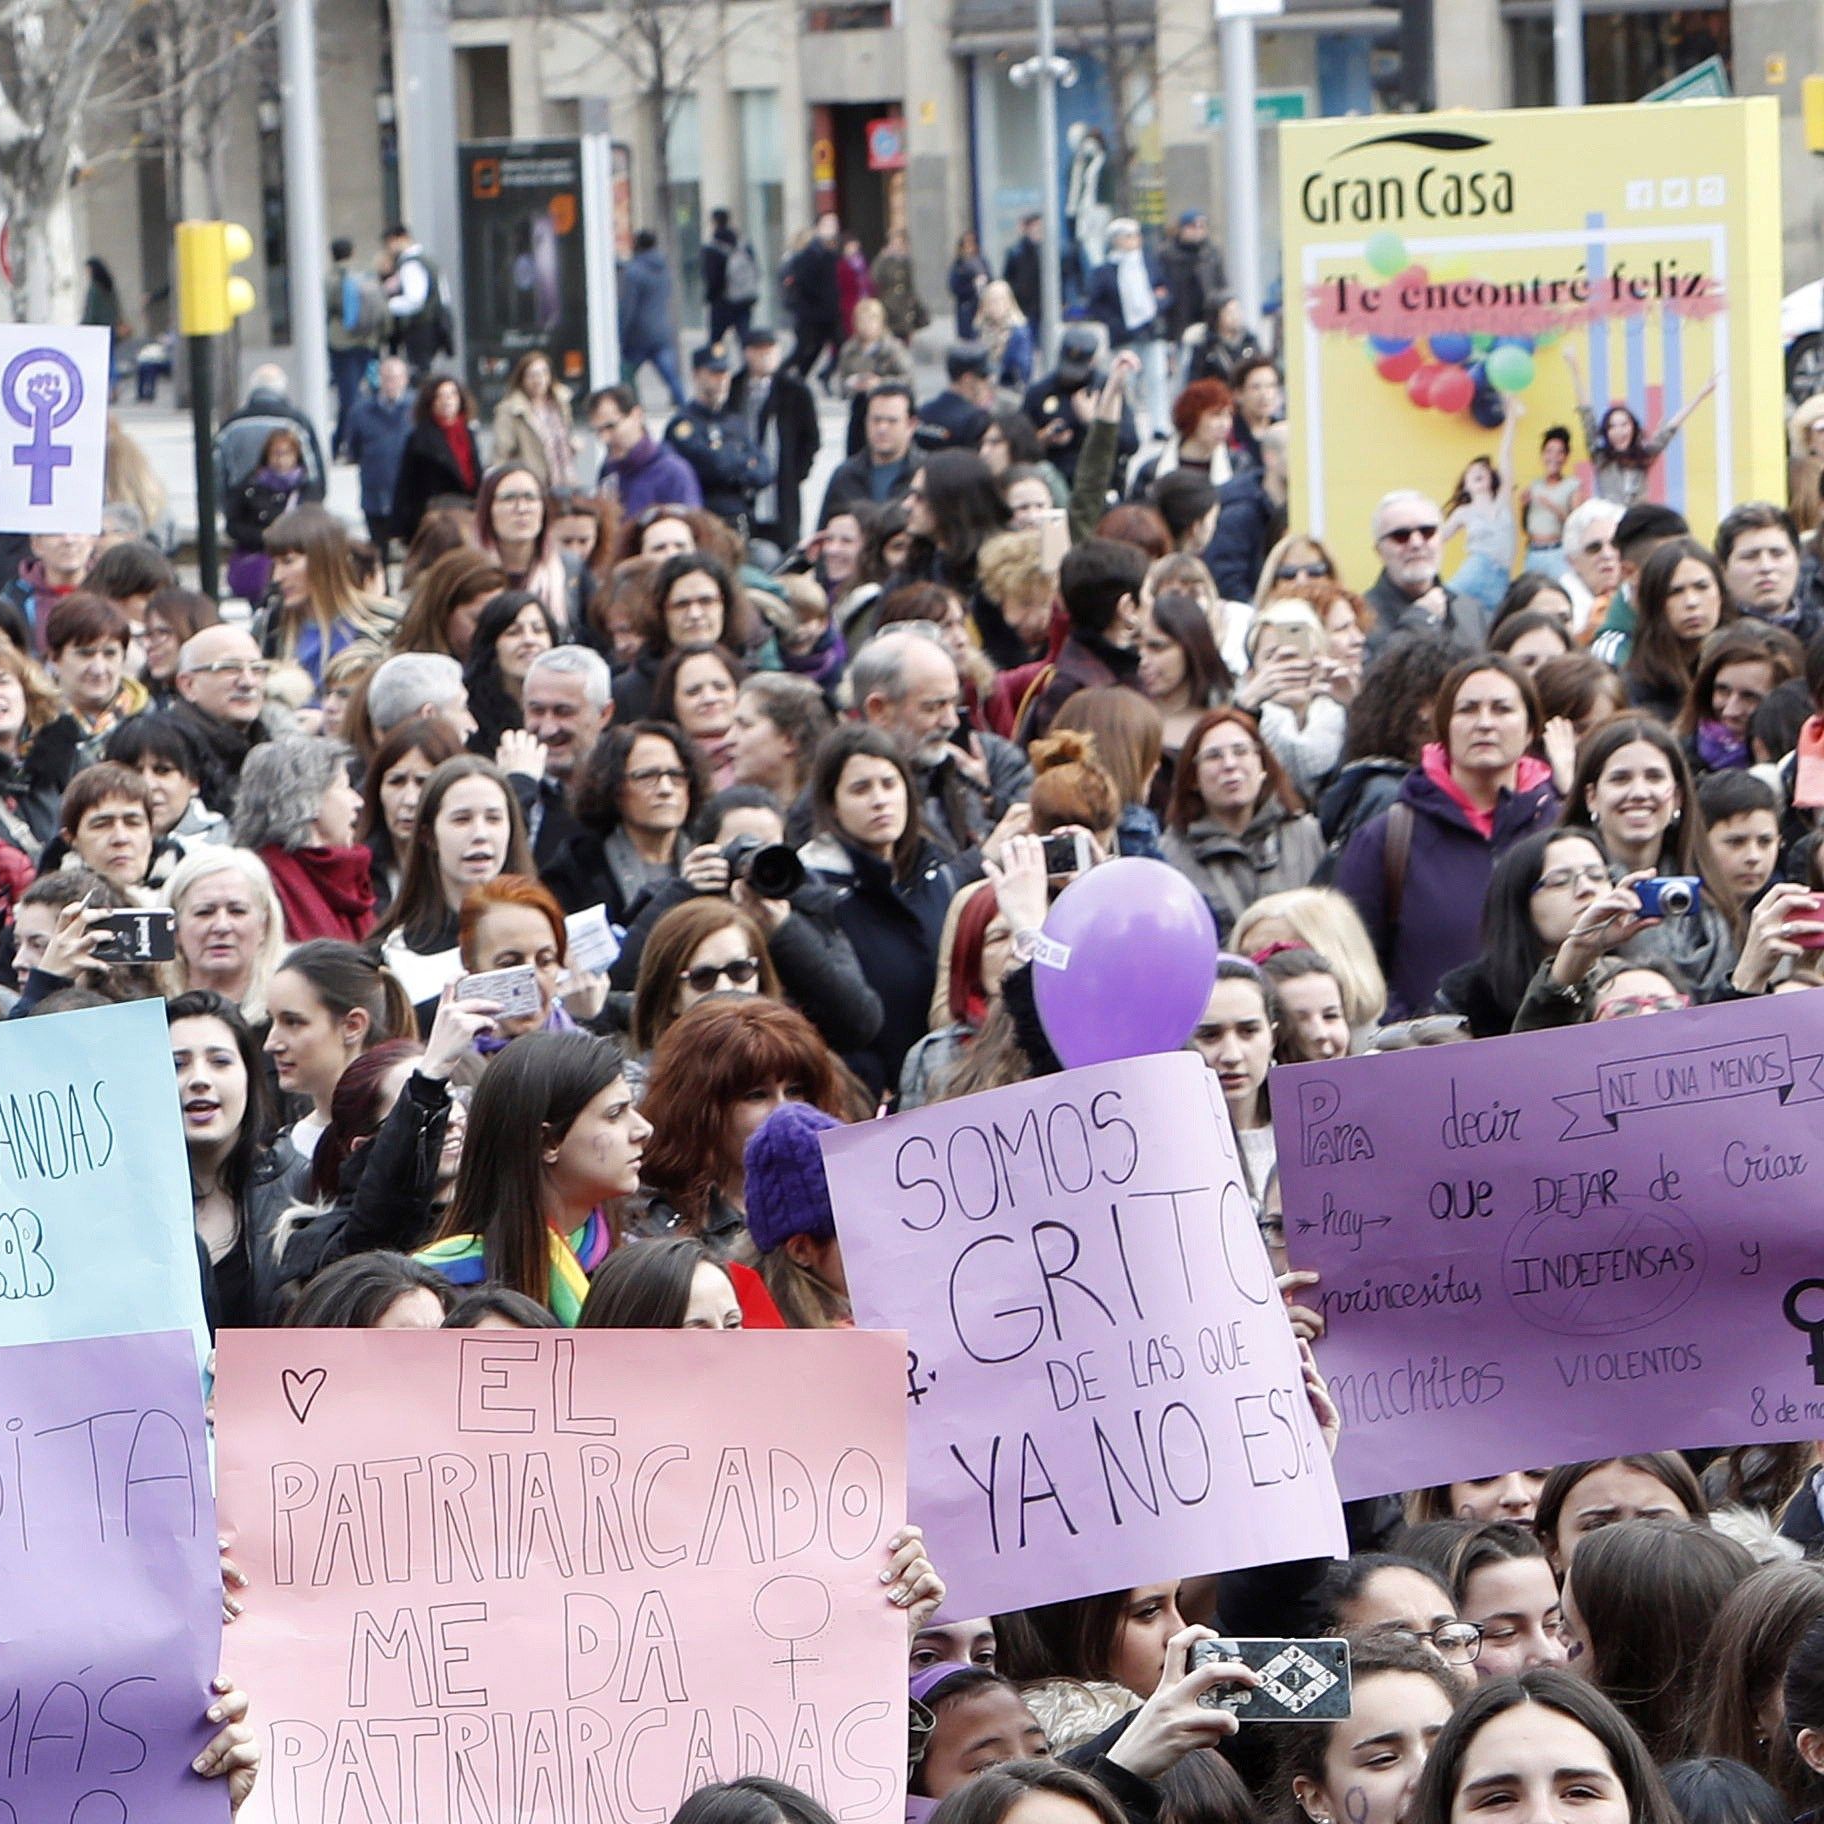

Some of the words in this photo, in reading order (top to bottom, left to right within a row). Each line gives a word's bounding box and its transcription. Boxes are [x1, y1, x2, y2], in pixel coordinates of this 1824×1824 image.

[1302, 172, 1403, 223] Gran
[1417, 166, 1514, 218] Casa
[1326, 273, 1382, 313] Te
[1401, 262, 1592, 310] encontré
[1610, 259, 1709, 301] feliz
[1441, 1078, 1522, 1151] decir
[1606, 1073, 1638, 1108] NI
[1653, 1065, 1700, 1101] UNA
[1710, 1052, 1786, 1090] MENOS
[894, 1090, 1140, 1231] SOMOS
[1320, 1191, 1363, 1253] hay
[1532, 1168, 1618, 1218] DEJAR
[1649, 1152, 1681, 1201] de
[949, 1179, 1271, 1364] GRITO
[1313, 1263, 1482, 1339] princesitas
[1511, 1243, 1695, 1297] INDEFENSAS
[458, 1338, 617, 1437] EL
[1046, 1350, 1107, 1412] DE
[1127, 1333, 1186, 1389] LAS
[1197, 1320, 1250, 1375] QUE
[1326, 1355, 1505, 1429] machitos
[1553, 1343, 1702, 1389] VIOLENTOS
[1752, 1386, 1768, 1427] 8
[1776, 1394, 1798, 1422] de
[271, 1443, 885, 1586] PATRIARCADO
[950, 1431, 1080, 1554] YA
[1092, 1401, 1211, 1526] NO
[348, 1602, 487, 1709] ME
[564, 1589, 689, 1703] DA
